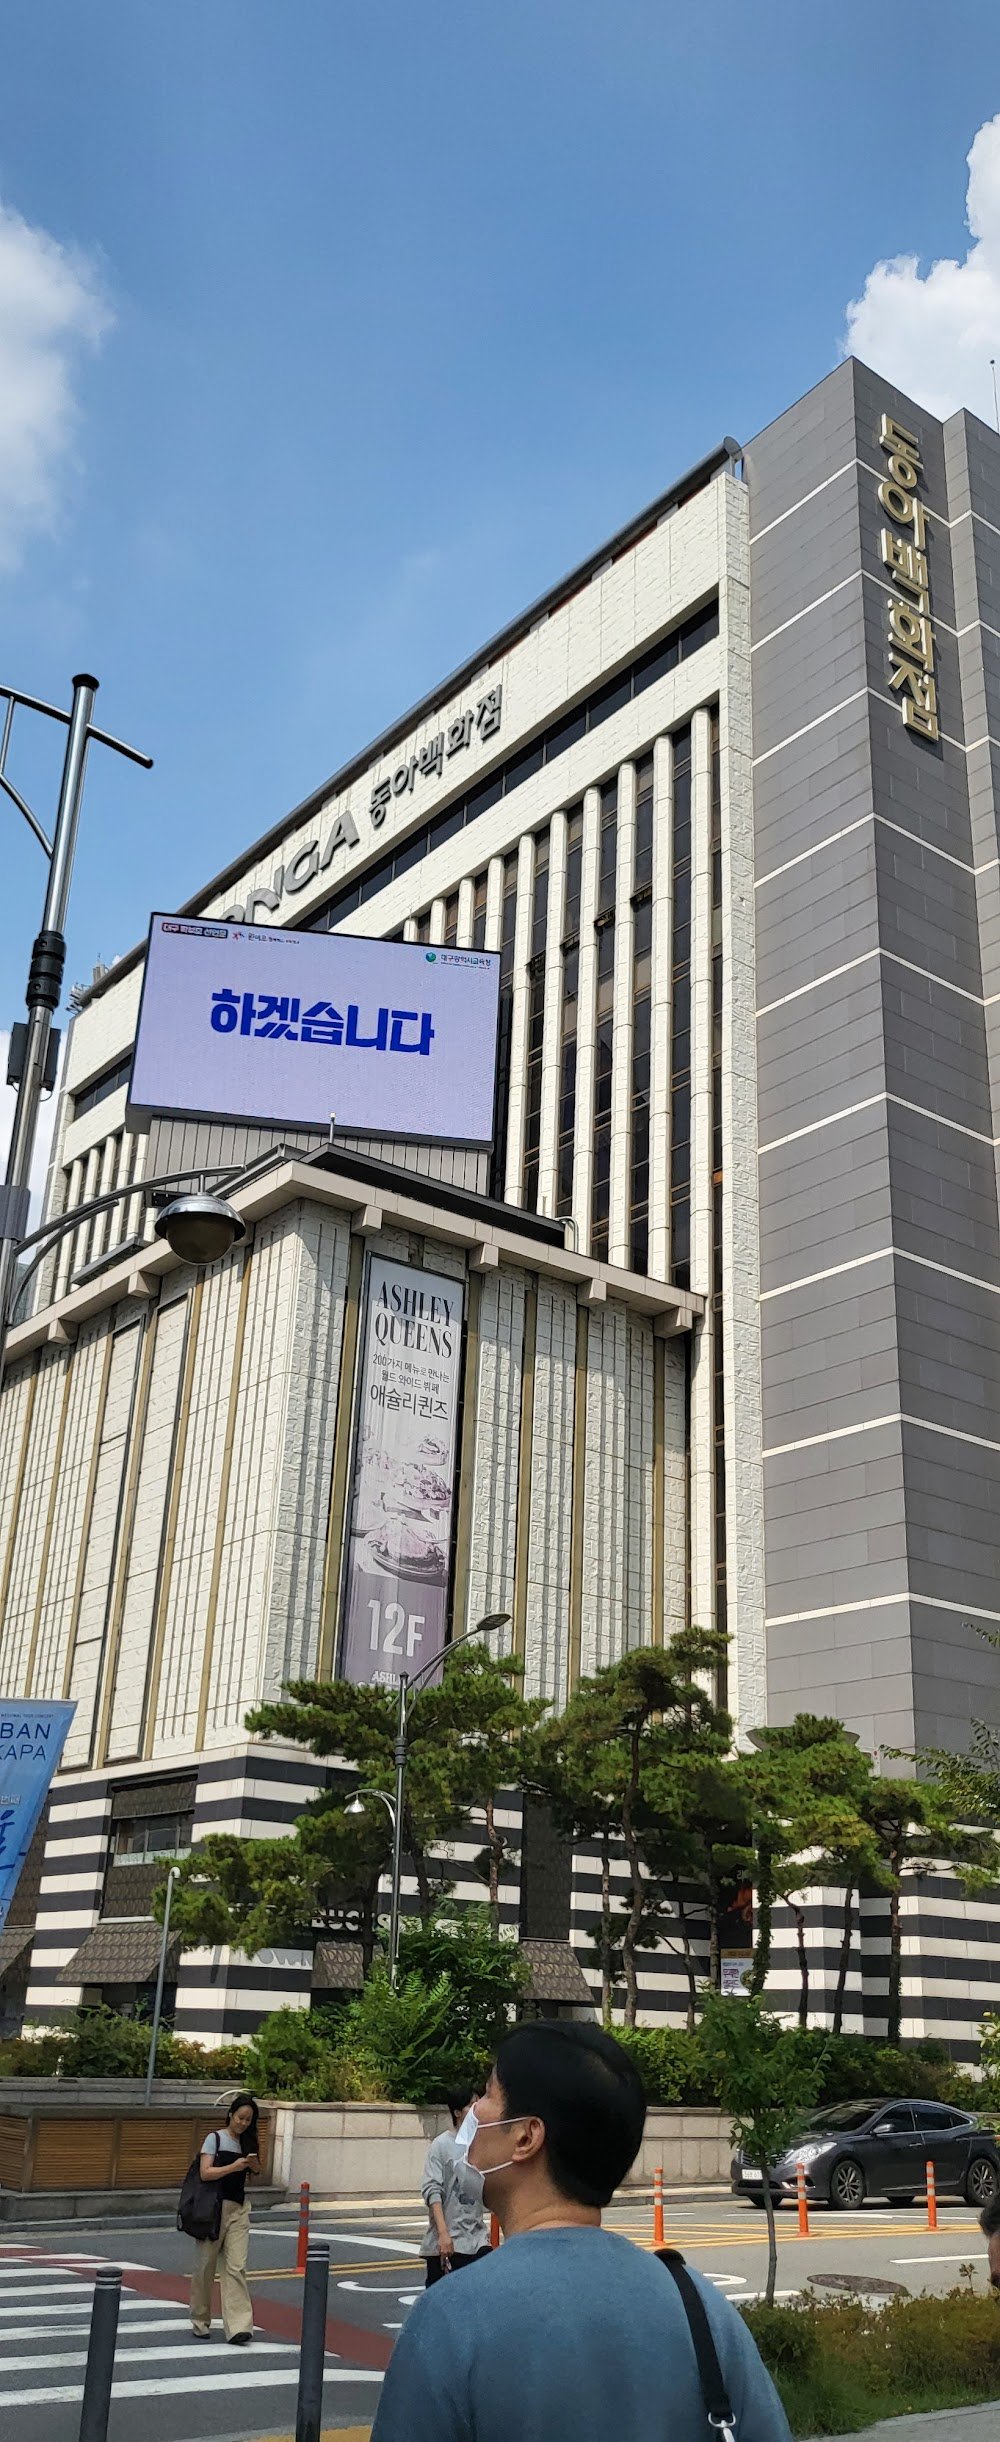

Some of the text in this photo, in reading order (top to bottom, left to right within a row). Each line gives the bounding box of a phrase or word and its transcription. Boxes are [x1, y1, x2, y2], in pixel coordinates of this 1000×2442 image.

[877, 413, 940, 742] 동아백화점
[369, 684, 502, 831] 동아백화점
[211, 988, 435, 1056] 하겠습니다
[376, 1281, 454, 1327] ASHLEY
[375, 1312, 452, 1359] QUEENS
[372, 1353, 450, 1383] 200가지 메뉴로 만나는
[399, 1374, 421, 1388] 와이드
[370, 1384, 449, 1420] 애슐리퀸즈
[368, 1599, 425, 1657] 12F
